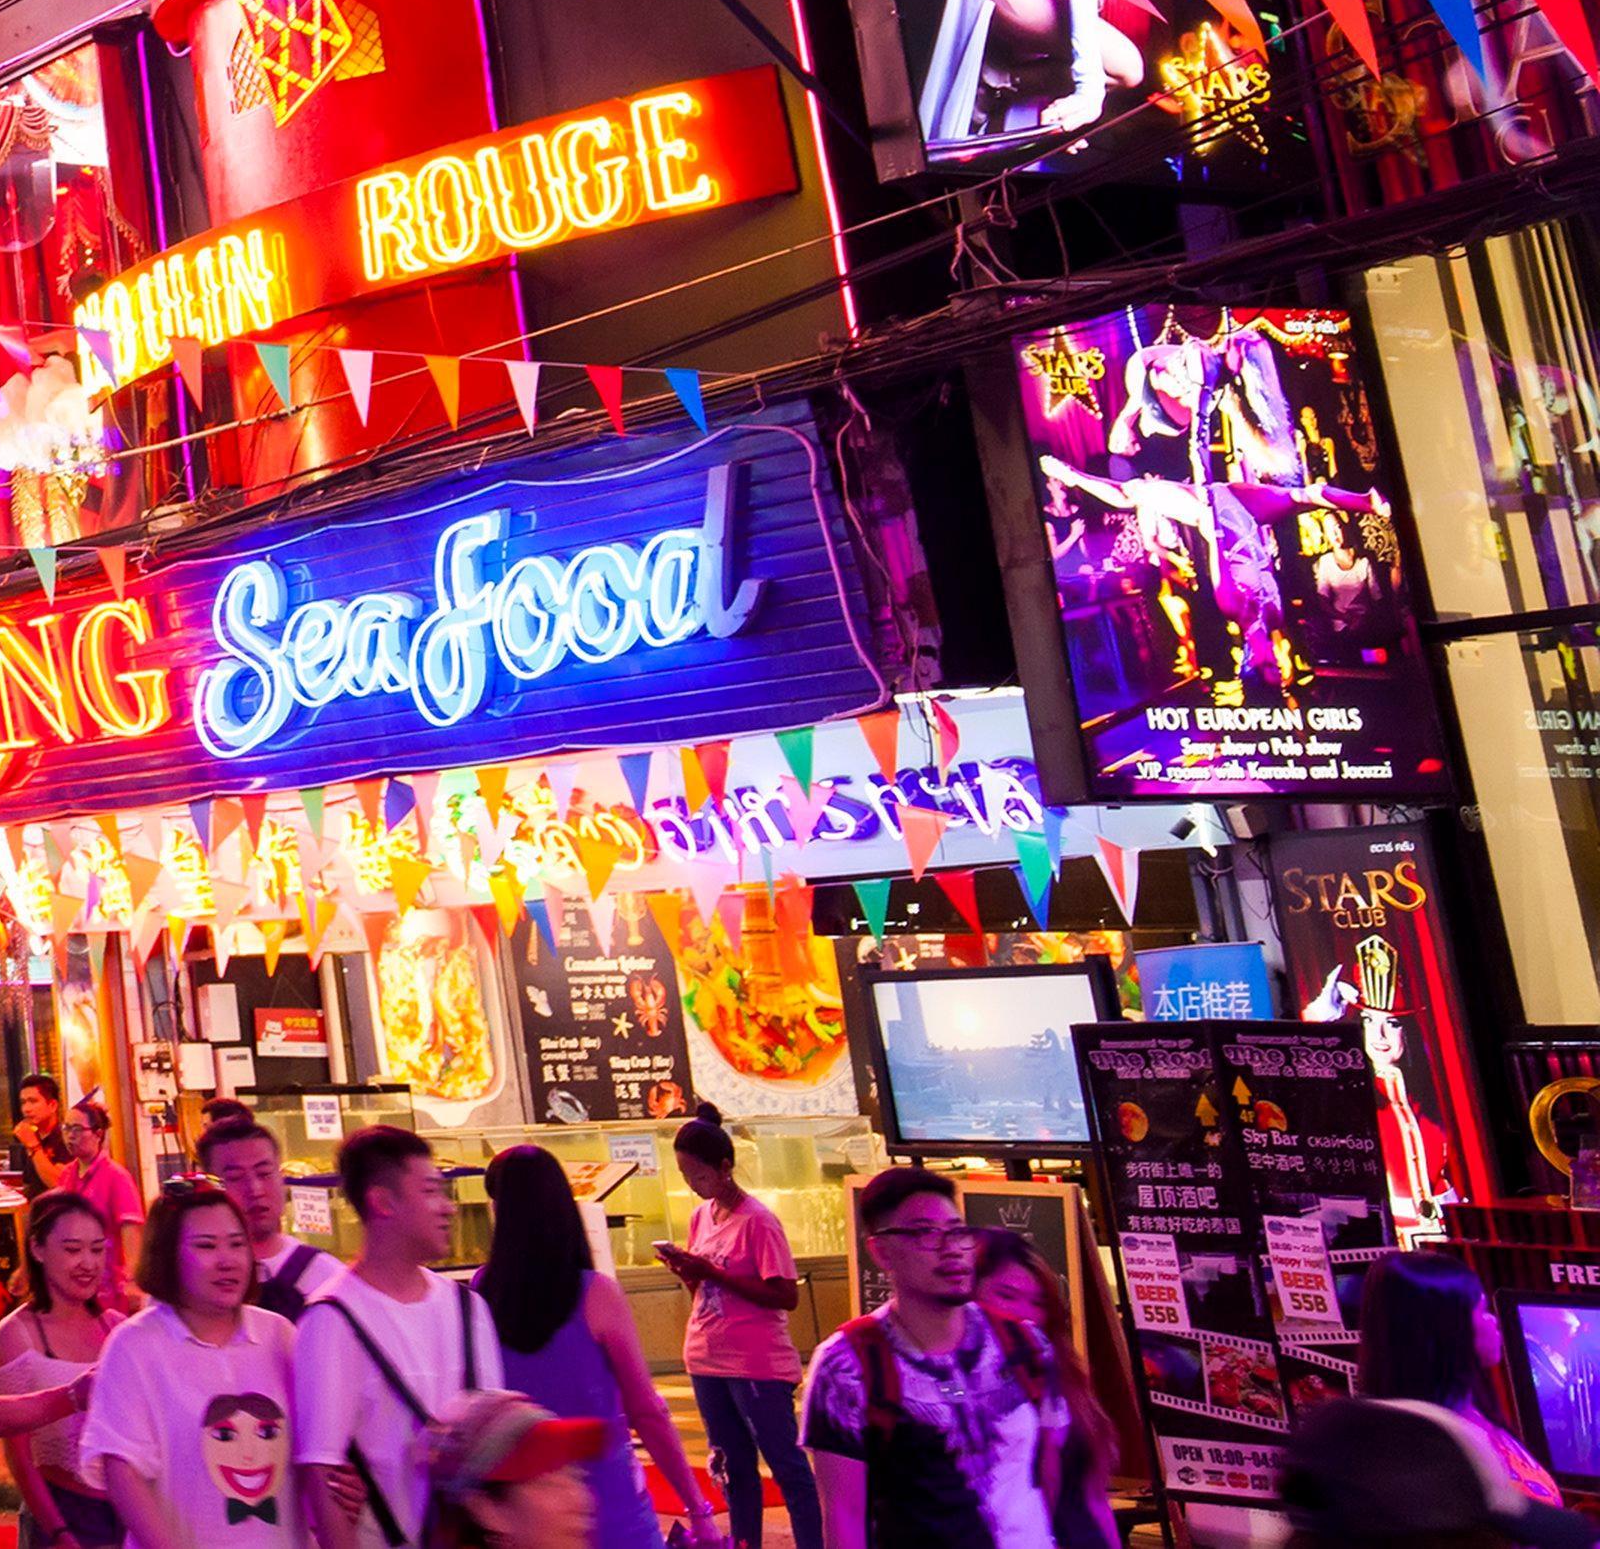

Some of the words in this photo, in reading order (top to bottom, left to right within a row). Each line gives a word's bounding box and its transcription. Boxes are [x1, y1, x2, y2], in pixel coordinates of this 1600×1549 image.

[356, 90, 720, 282] ROUGE
[1021, 343, 1106, 381] STARS
[1049, 376, 1090, 395] CLUB
[195, 455, 767, 760] Seafood
[1146, 708, 1190, 731] HOT
[1194, 707, 1304, 731] EUROPEAN
[1307, 707, 1364, 731] GIRLS
[1220, 736, 1257, 756] show
[1270, 736, 1304, 757] Pole
[1306, 736, 1342, 756] show
[1137, 762, 1164, 780] VIP
[1215, 760, 1246, 780] with
[1247, 760, 1308, 781] Karaoke
[1310, 759, 1339, 780] and
[1341, 760, 1393, 780] Jacuzzi
[1282, 859, 1427, 914] STARS
[1333, 908, 1387, 930] CLUB
[1153, 981, 1253, 1020] 本店推荐
[1089, 1049, 1146, 1070] The
[1148, 1049, 1213, 1070] Roof
[1223, 1045, 1286, 1067] The
[1290, 1046, 1366, 1070] Roof
[1241, 1129, 1269, 1148] Sky
[1270, 1129, 1299, 1147] Bar
[1307, 1131, 1375, 1151] скай-бар
[1125, 1161, 1223, 1179] 步行街上唯一的
[1248, 1152, 1306, 1172] 空中酒吧
[1137, 1185, 1220, 1210] 屋顶酒吧
[1127, 1215, 1242, 1235] 有非常好吃的泰国
[1272, 1254, 1303, 1269] Happy
[1127, 1271, 1156, 1282] Happy
[1280, 1270, 1328, 1292] BEER
[1134, 1284, 1180, 1304] BEER
[1289, 1292, 1328, 1314] 55B
[1143, 1304, 1180, 1325] 55B
[1172, 1444, 1205, 1462] OPEN
